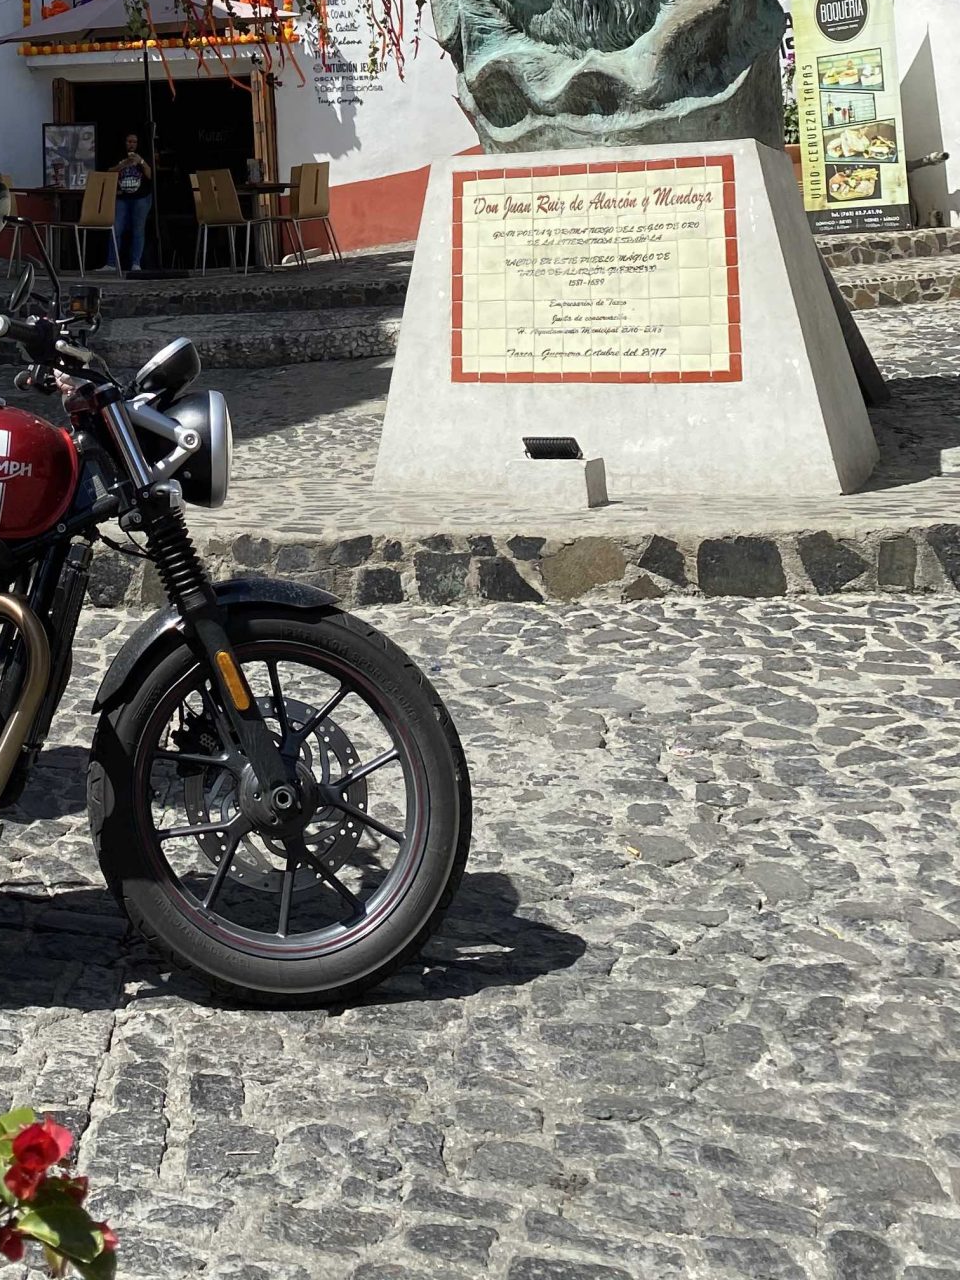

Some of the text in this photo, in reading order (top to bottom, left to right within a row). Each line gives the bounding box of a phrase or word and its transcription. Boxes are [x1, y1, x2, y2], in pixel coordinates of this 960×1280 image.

[802, 64, 815, 101] TAPAS
[806, 108, 819, 162] CERVEZA
[811, 171, 822, 199] VINO
[473, 186, 714, 220] Don Juan Ruiz de Alarcón y Mendoza
[681, 221, 700, 229] ORO
[656, 252, 670, 261] DE
[623, 348, 639, 357] del
